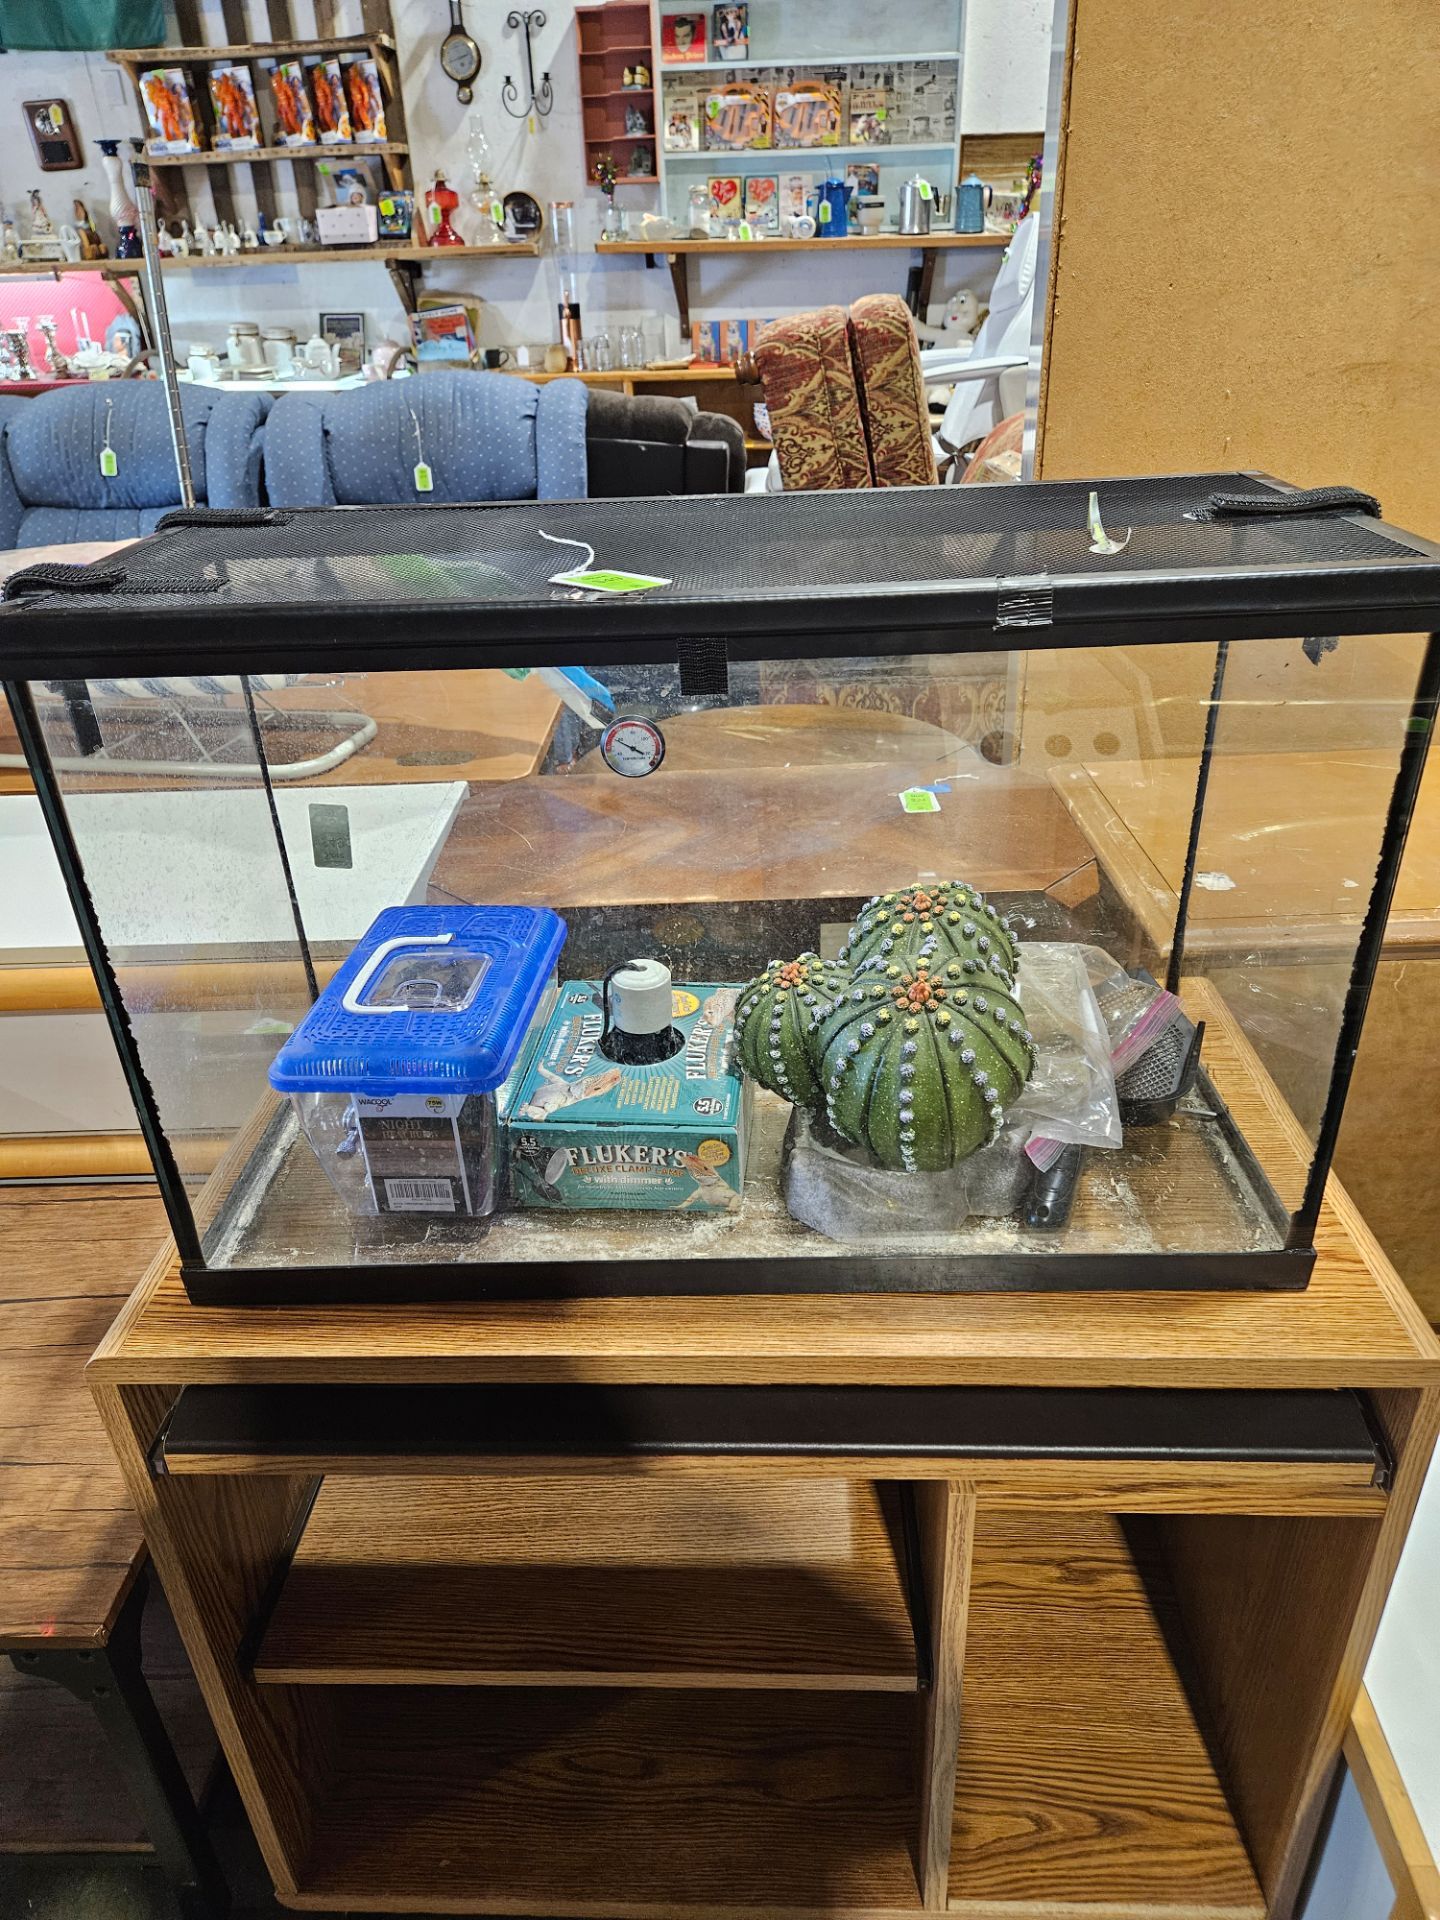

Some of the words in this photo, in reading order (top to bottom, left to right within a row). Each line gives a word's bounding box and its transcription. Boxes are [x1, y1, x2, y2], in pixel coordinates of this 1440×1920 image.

[564, 1013, 603, 1078] FLUKER'S
[381, 1119, 423, 1130] NIGHT
[520, 1136, 537, 1148] 5.5
[564, 1145, 688, 1169] FLUKER'S
[615, 1164, 652, 1174] CLAMP
[594, 1175, 618, 1185] with
[619, 1175, 663, 1186] dimmer
